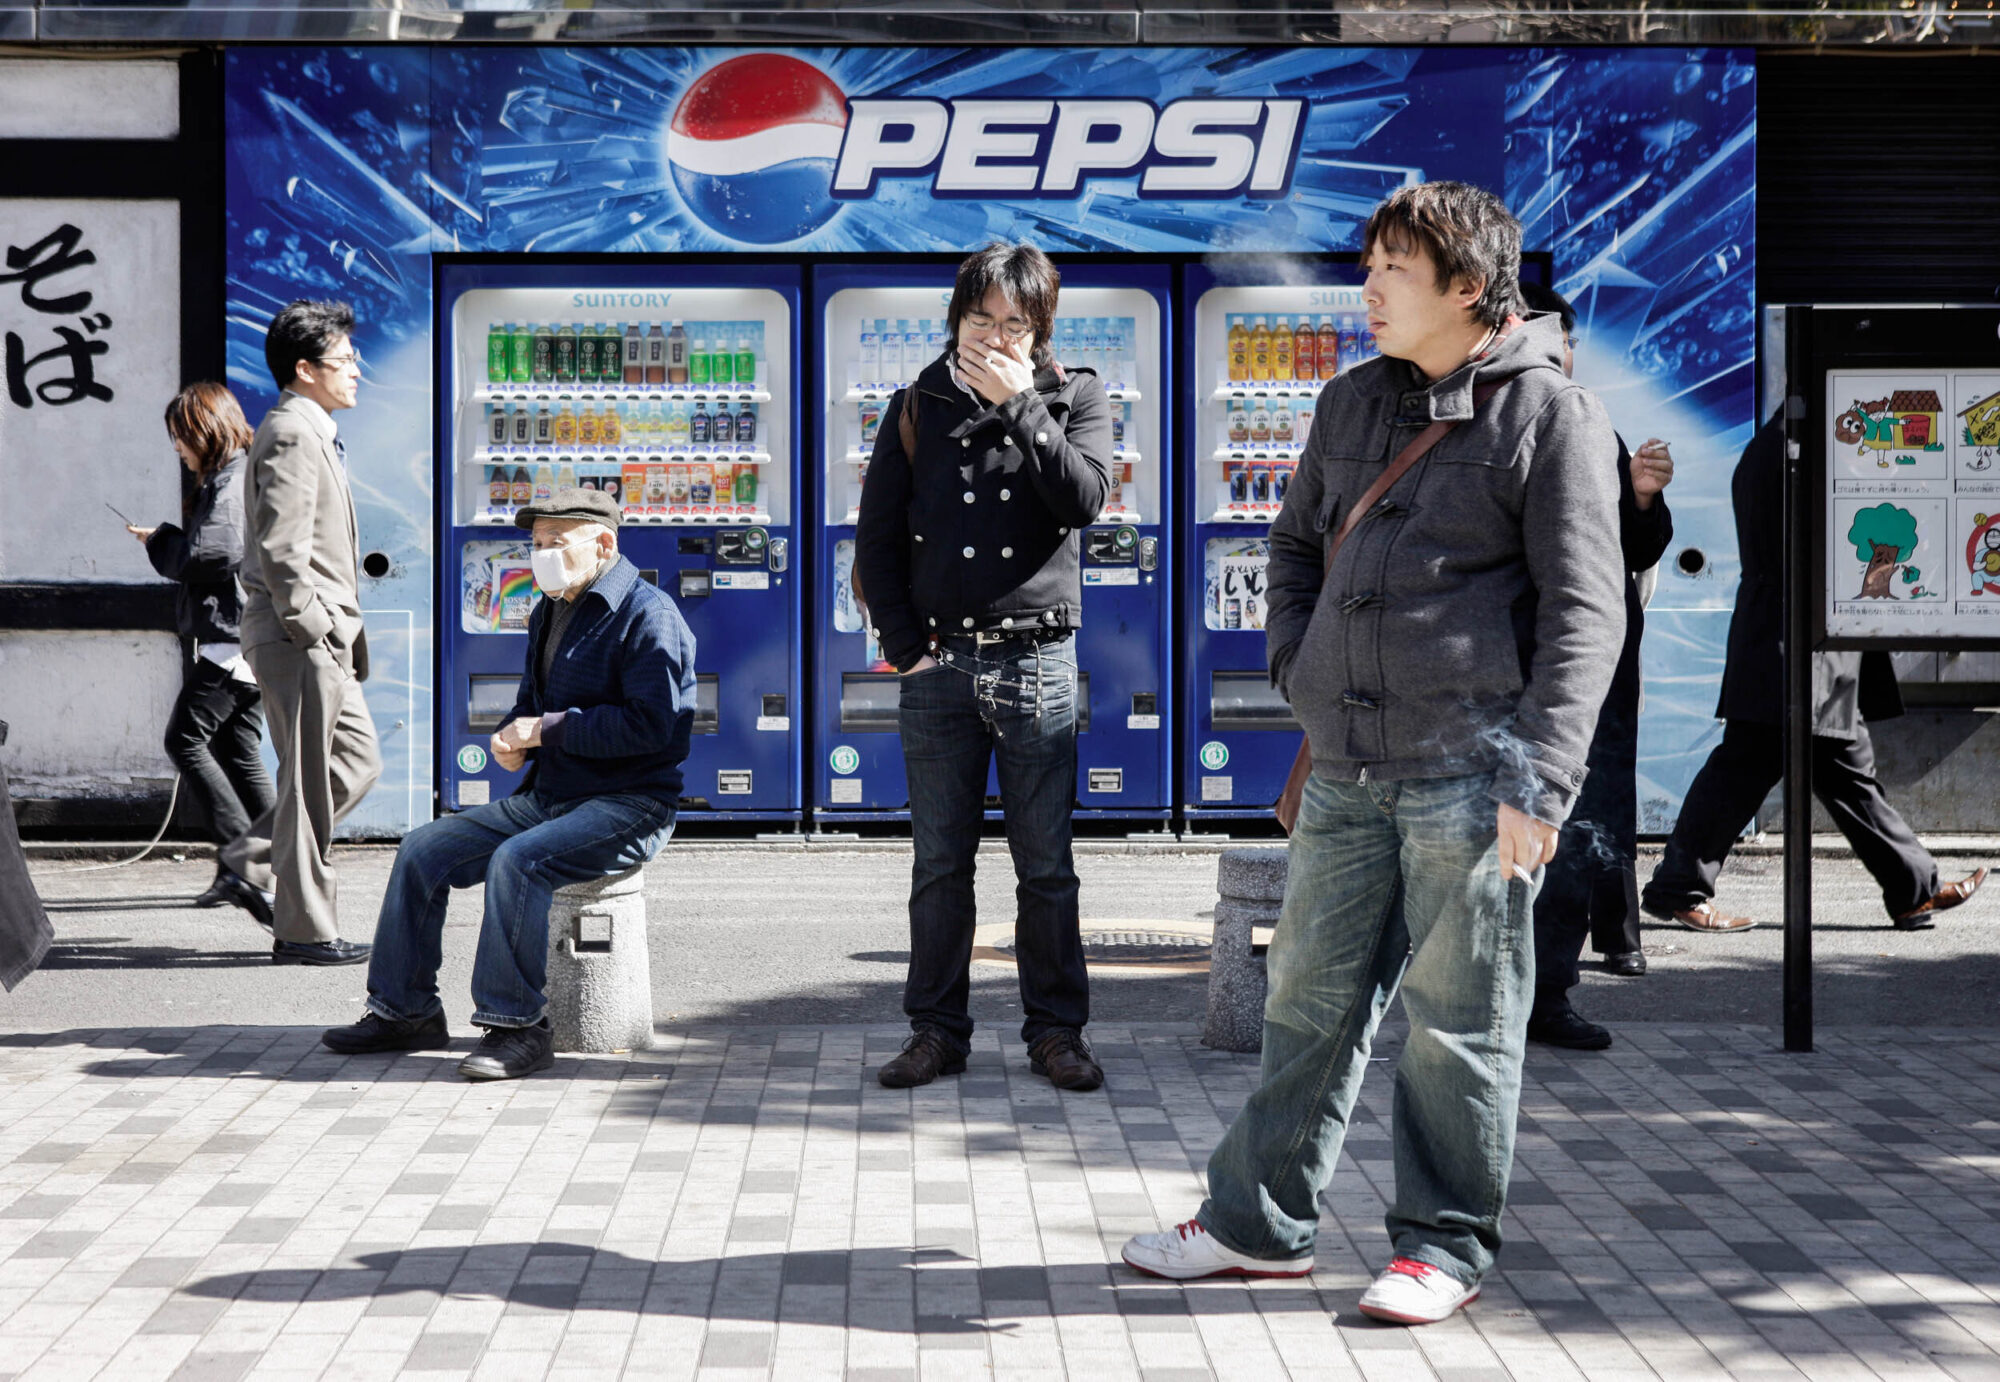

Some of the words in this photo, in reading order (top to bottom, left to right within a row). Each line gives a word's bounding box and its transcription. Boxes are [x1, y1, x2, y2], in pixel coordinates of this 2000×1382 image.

[833, 99, 1303, 192] PEPSI
[0, 223, 114, 409] そば
[573, 293, 672, 308] SUNTORY
[1310, 291, 1362, 306] SUNT
